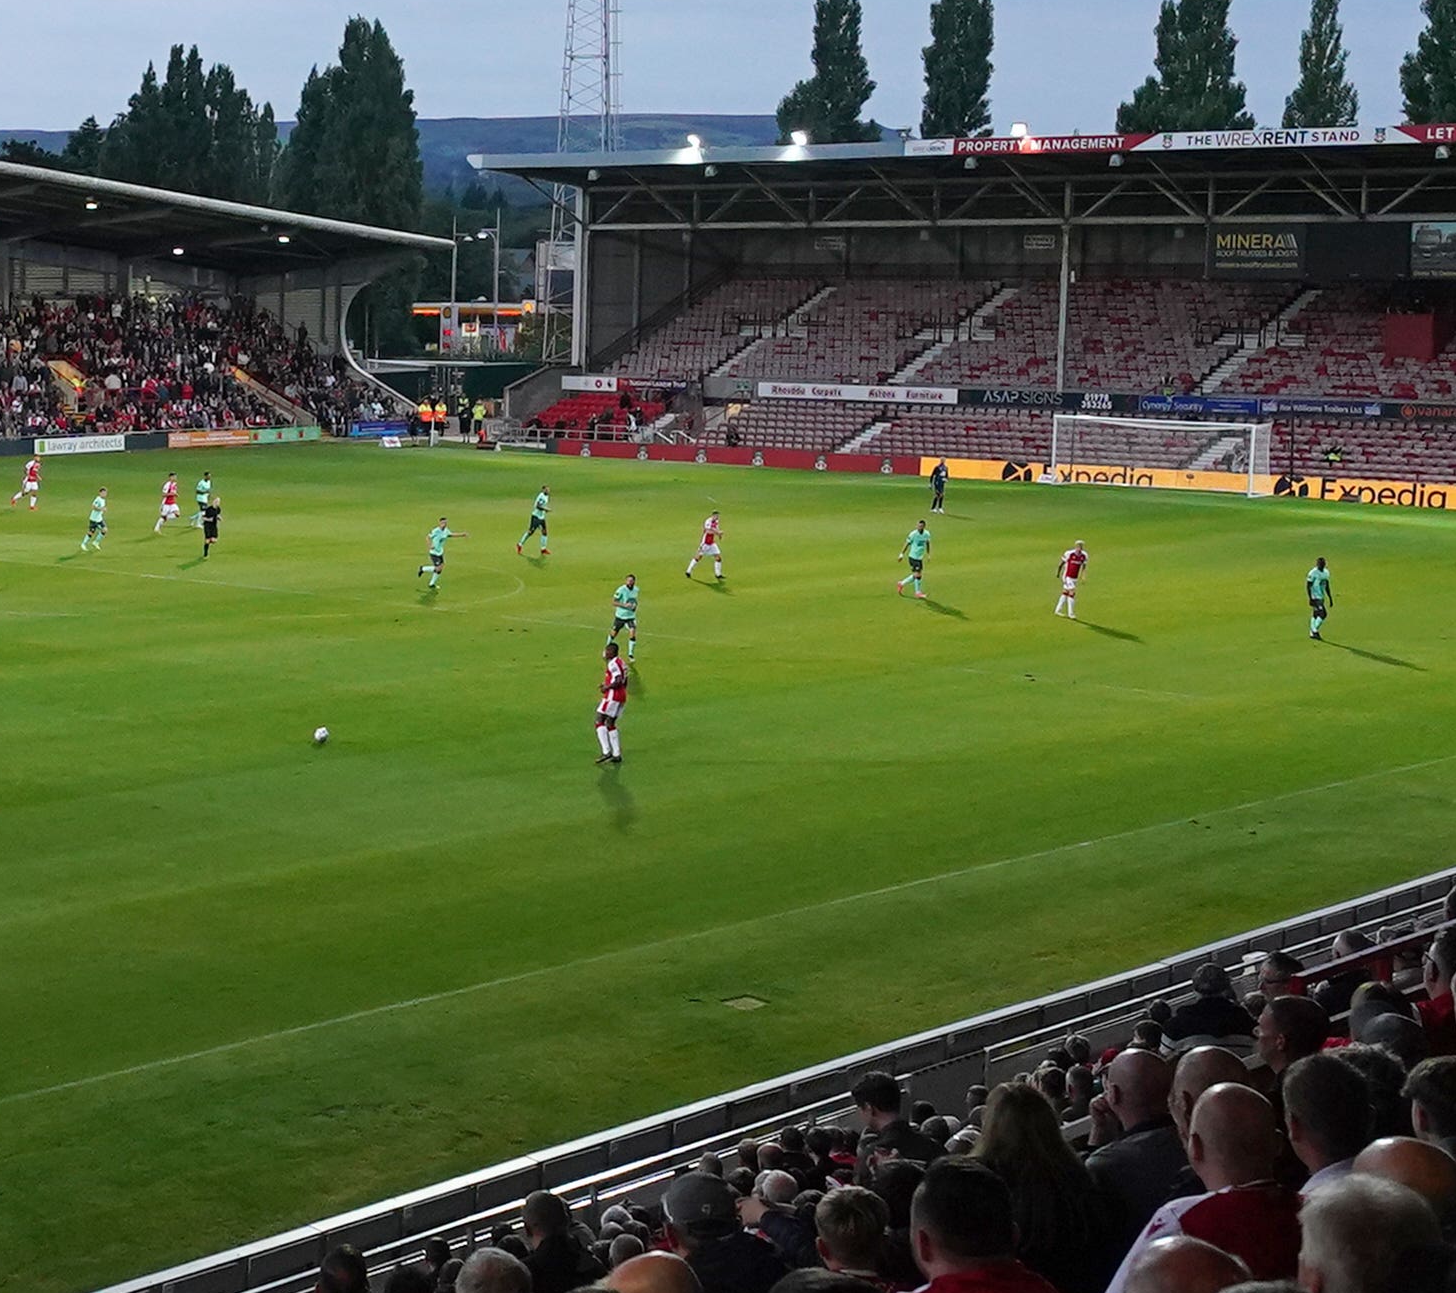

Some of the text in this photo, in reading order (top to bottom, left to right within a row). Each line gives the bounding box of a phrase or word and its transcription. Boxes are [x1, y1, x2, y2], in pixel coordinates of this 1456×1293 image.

[1187, 130, 1360, 146] THE WREXRENT STAND
[1426, 126, 1456, 140] LET
[957, 136, 1126, 153] PROPERTY MANAGEMENT
[1215, 233, 1285, 249] MINERA
[982, 390, 1064, 405] ASAP SIGNS
[1320, 478, 1447, 509] Expedia
